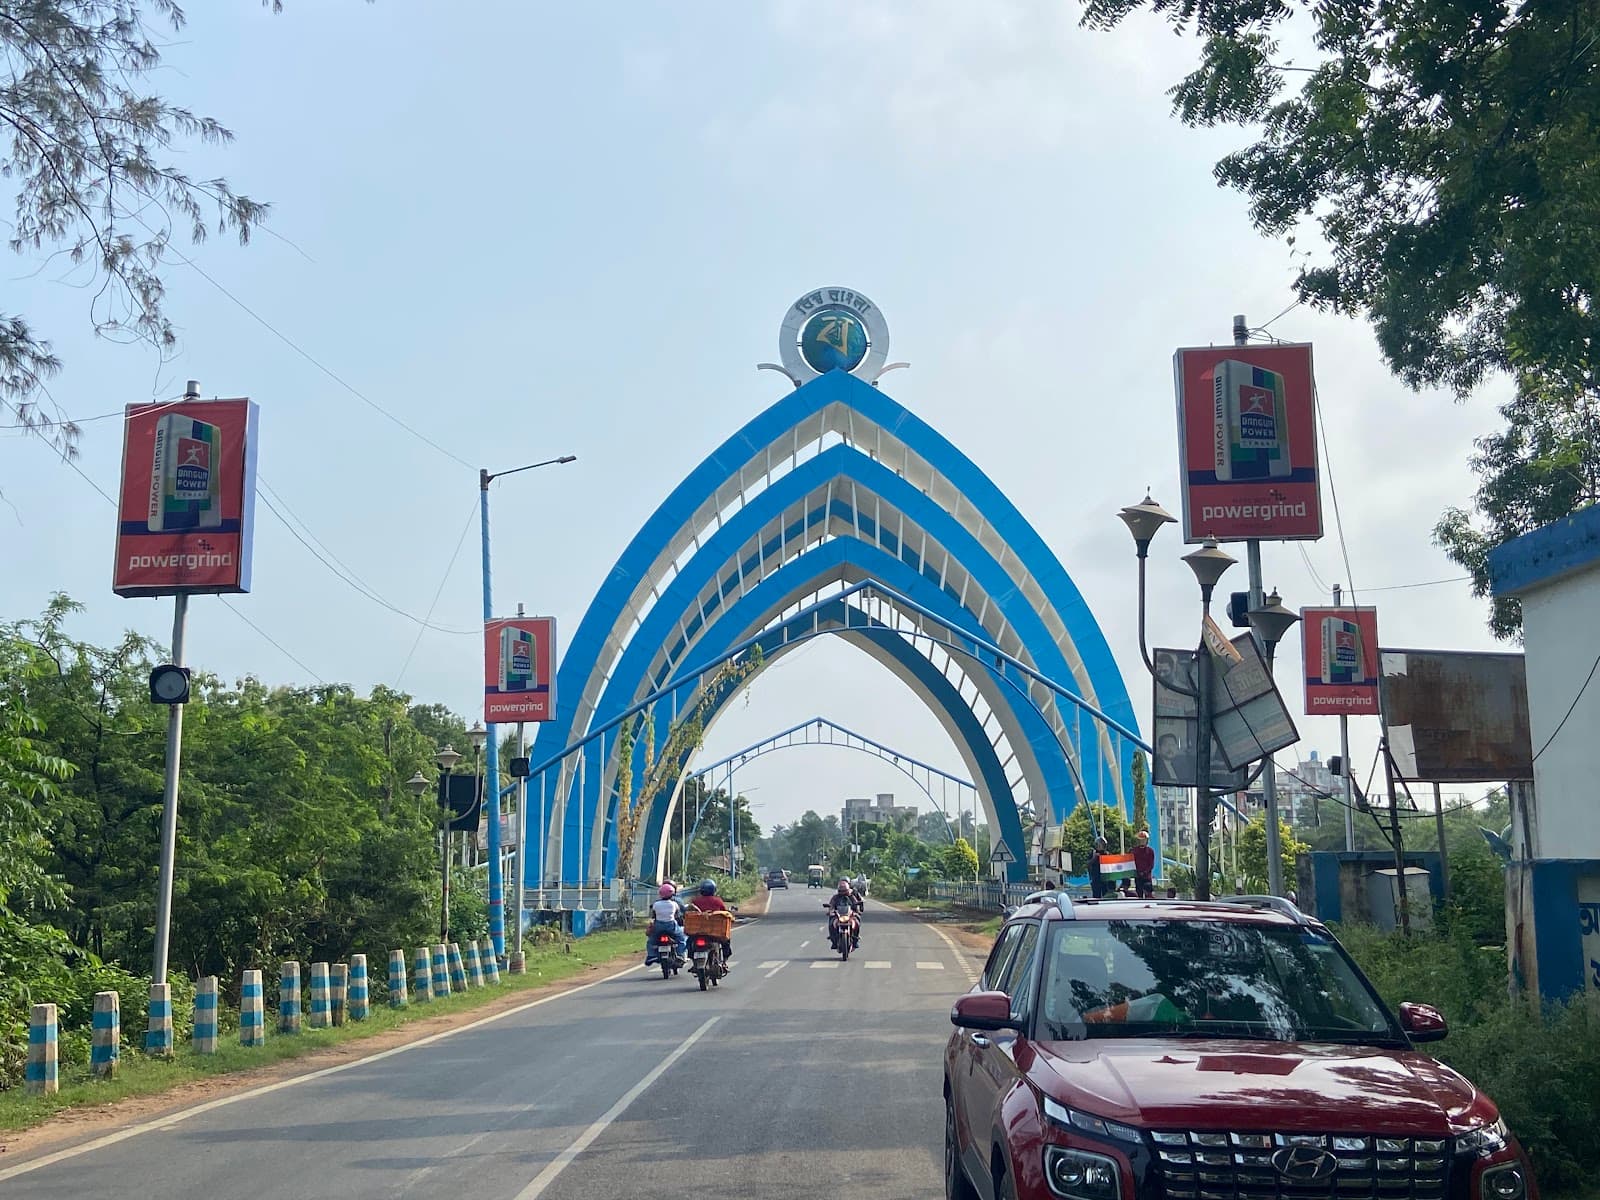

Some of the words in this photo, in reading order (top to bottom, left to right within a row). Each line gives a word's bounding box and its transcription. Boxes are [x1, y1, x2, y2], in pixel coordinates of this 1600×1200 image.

[795, 291, 823, 314] বিশ্ব
[828, 290, 871, 314] বাংলা
[1242, 428, 1274, 436] POWER
[153, 429, 164, 471] BANGUR
[1216, 423, 1224, 466] POWER
[177, 479, 208, 488] POWER
[150, 475, 160, 518] POWER
[1202, 502, 1306, 521] powergrind
[129, 551, 232, 570] powergrind
[490, 702, 543, 713] powergrind
[1313, 695, 1372, 706] powergrind
